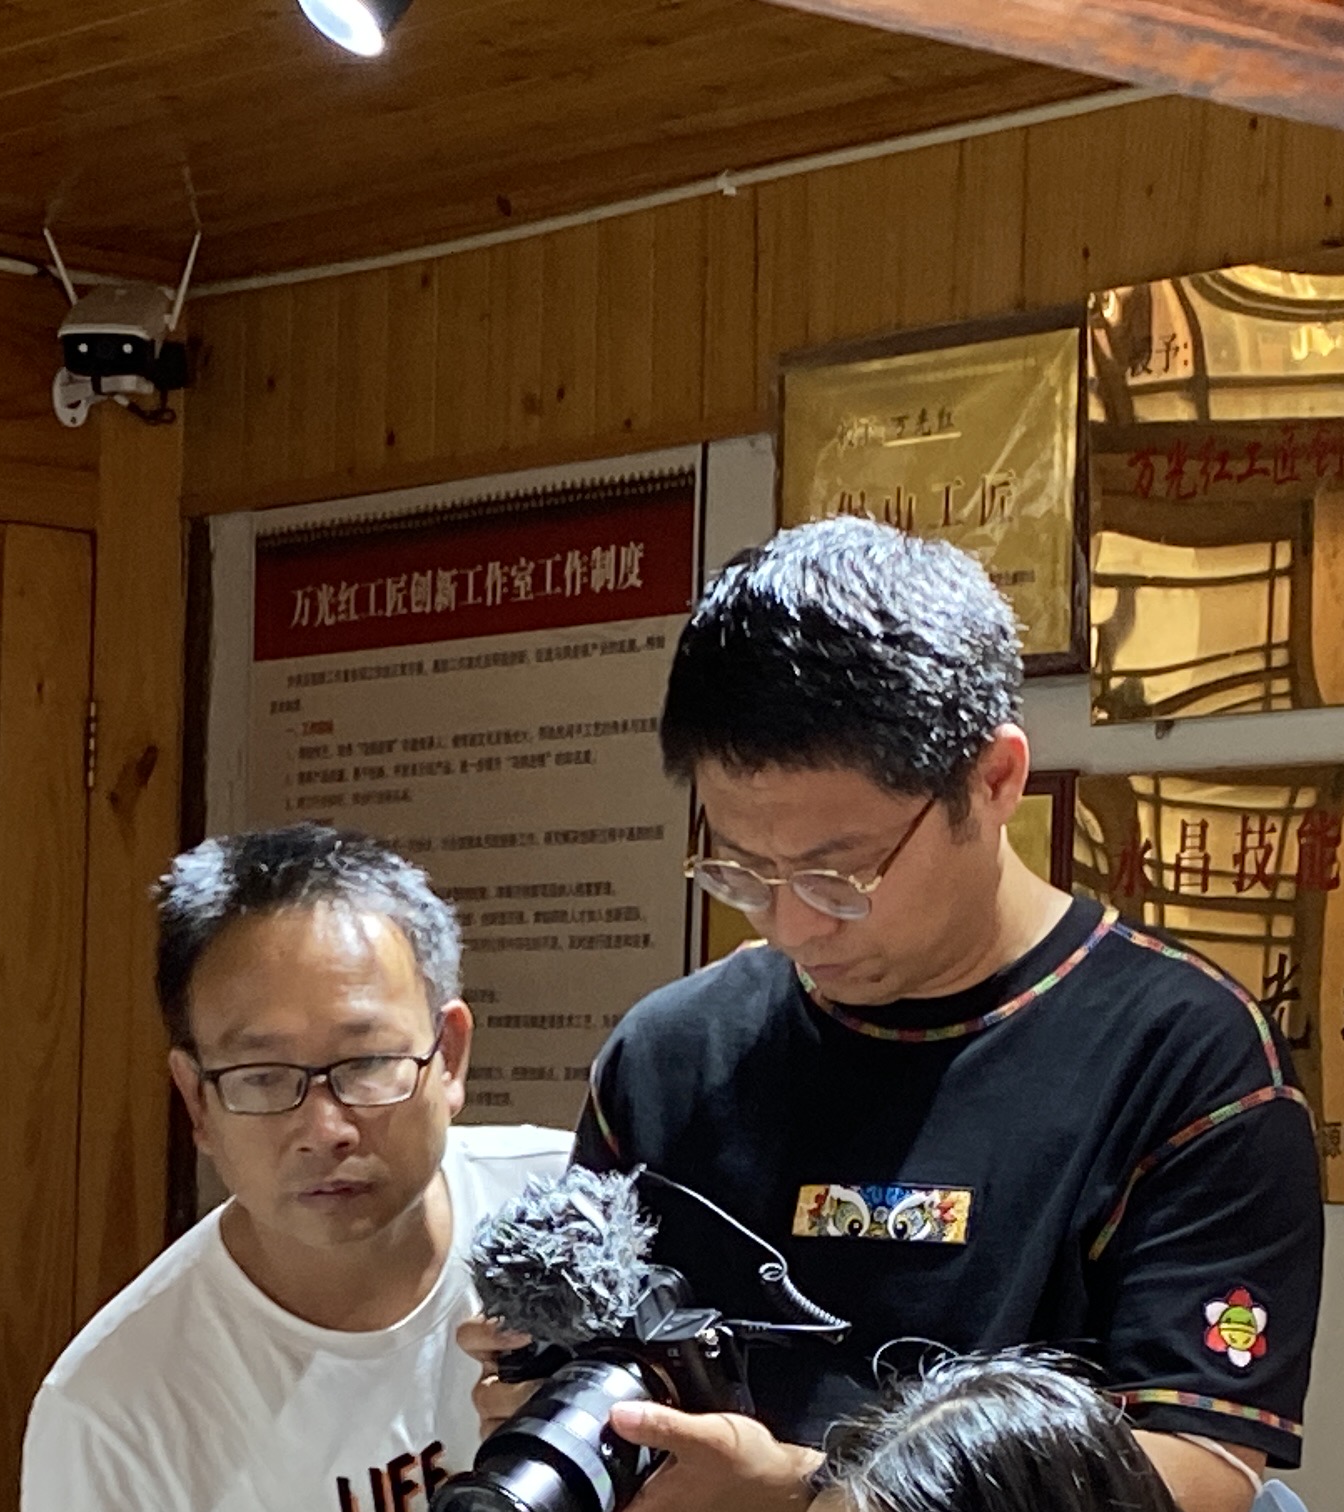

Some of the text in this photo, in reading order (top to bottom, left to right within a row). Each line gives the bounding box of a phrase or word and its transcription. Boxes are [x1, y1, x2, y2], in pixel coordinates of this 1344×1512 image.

[289, 541, 644, 628] 万光红工匠创新工作室工作制度
